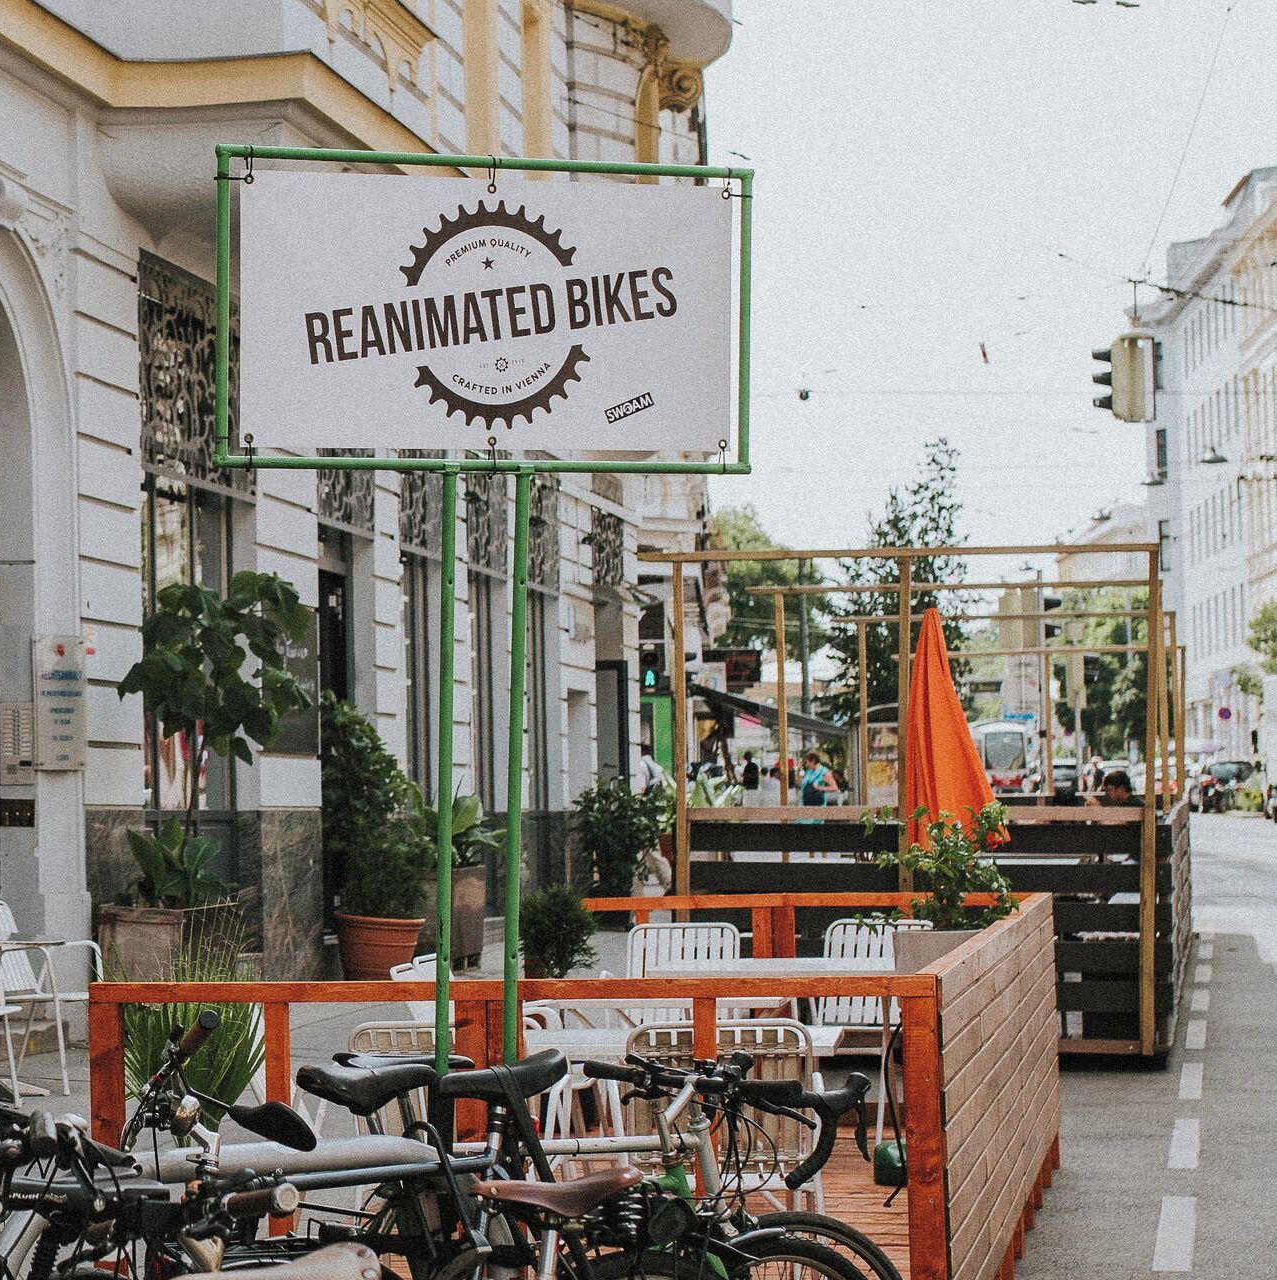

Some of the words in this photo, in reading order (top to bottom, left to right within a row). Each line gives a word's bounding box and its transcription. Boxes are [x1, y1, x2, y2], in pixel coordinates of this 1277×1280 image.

[444, 238, 487, 267] PREMIUM
[489, 238, 532, 259] QUALITY
[304, 282, 556, 366] REANIMATED
[565, 266, 678, 330] BIKES
[452, 373, 498, 395] CRAFTED
[501, 384, 513, 394] IN
[515, 362, 552, 390] VIENNA
